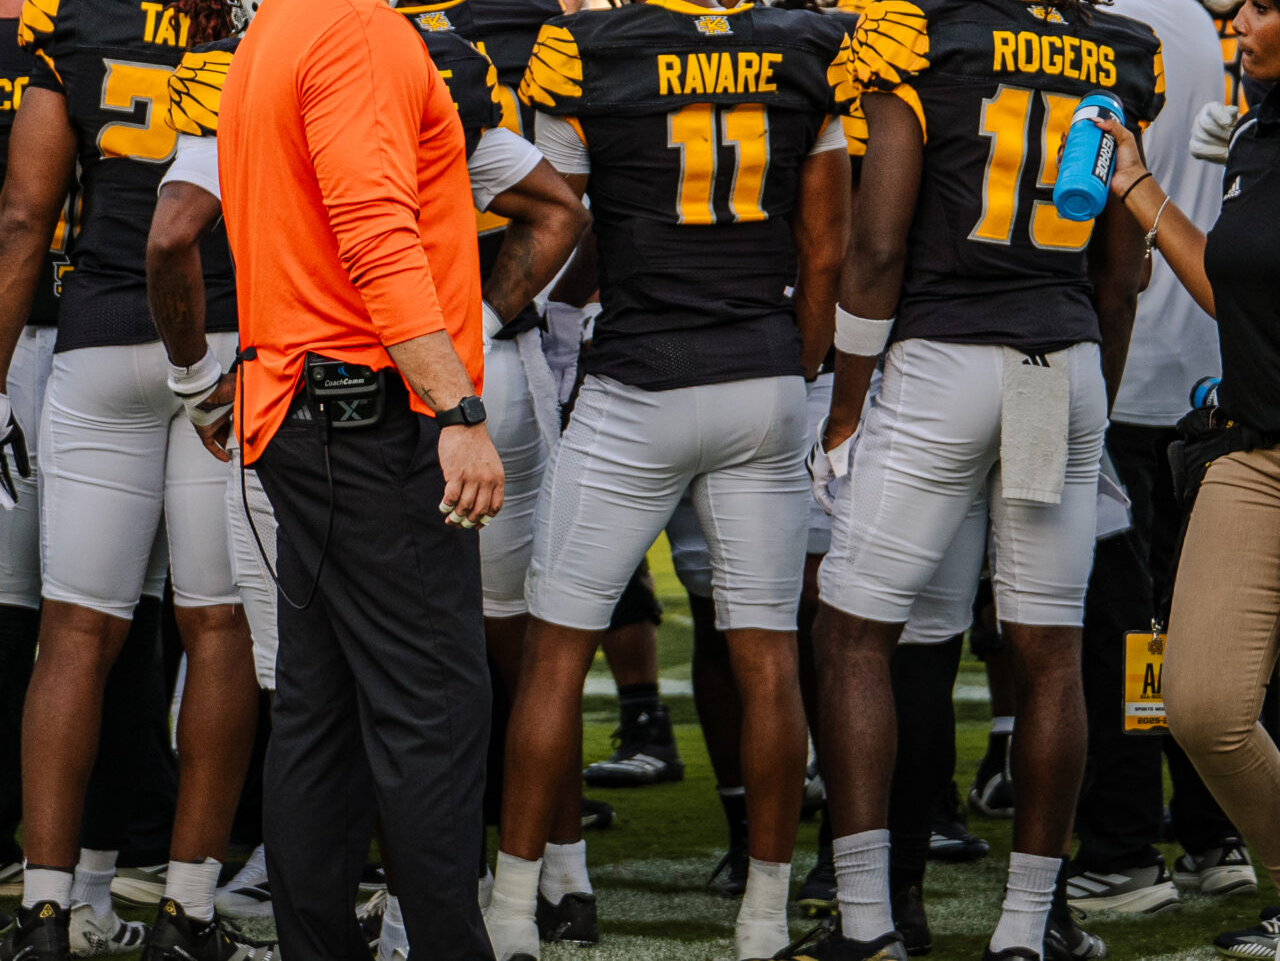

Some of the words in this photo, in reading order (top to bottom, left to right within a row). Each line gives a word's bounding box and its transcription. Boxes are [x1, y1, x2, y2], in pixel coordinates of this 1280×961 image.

[657, 51, 783, 96] RAVARE
[992, 29, 1118, 88] ROGERS
[666, 102, 770, 226] 11
[324, 377, 365, 388] CoachComm
